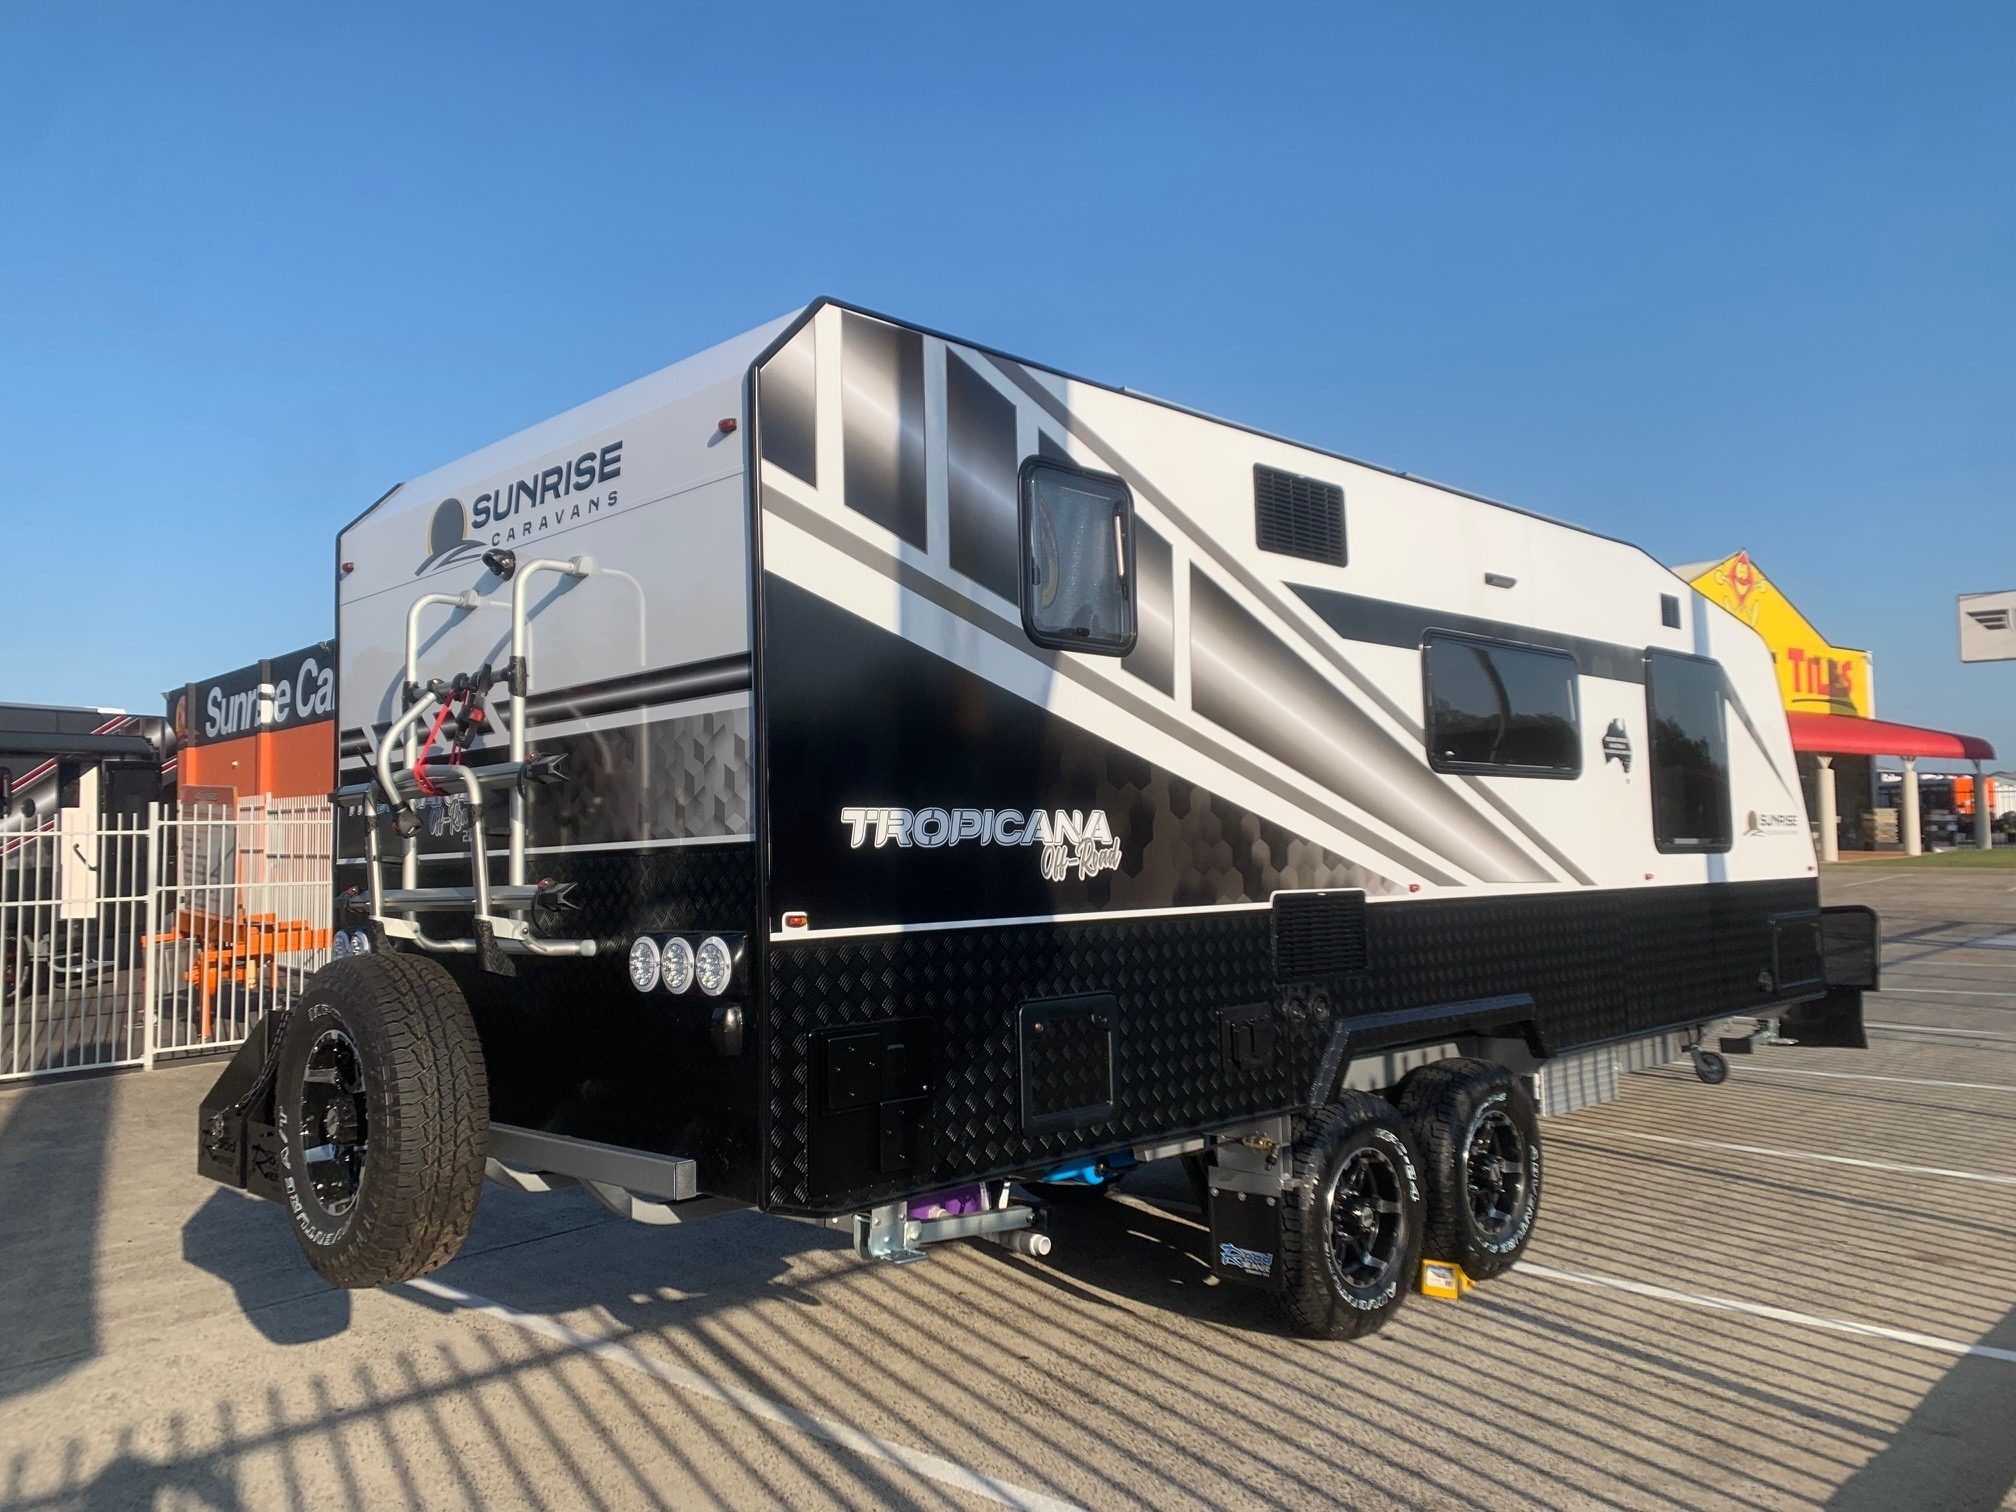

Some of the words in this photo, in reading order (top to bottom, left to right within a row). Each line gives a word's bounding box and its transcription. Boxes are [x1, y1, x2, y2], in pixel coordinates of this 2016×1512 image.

[471, 440, 623, 529] SUNRISE
[491, 490, 618, 546] CARAVANS
[840, 807, 1113, 849] TROPICANA
[1760, 814, 1798, 826] SUNRISE
[1041, 837, 1122, 882] Off-Road
